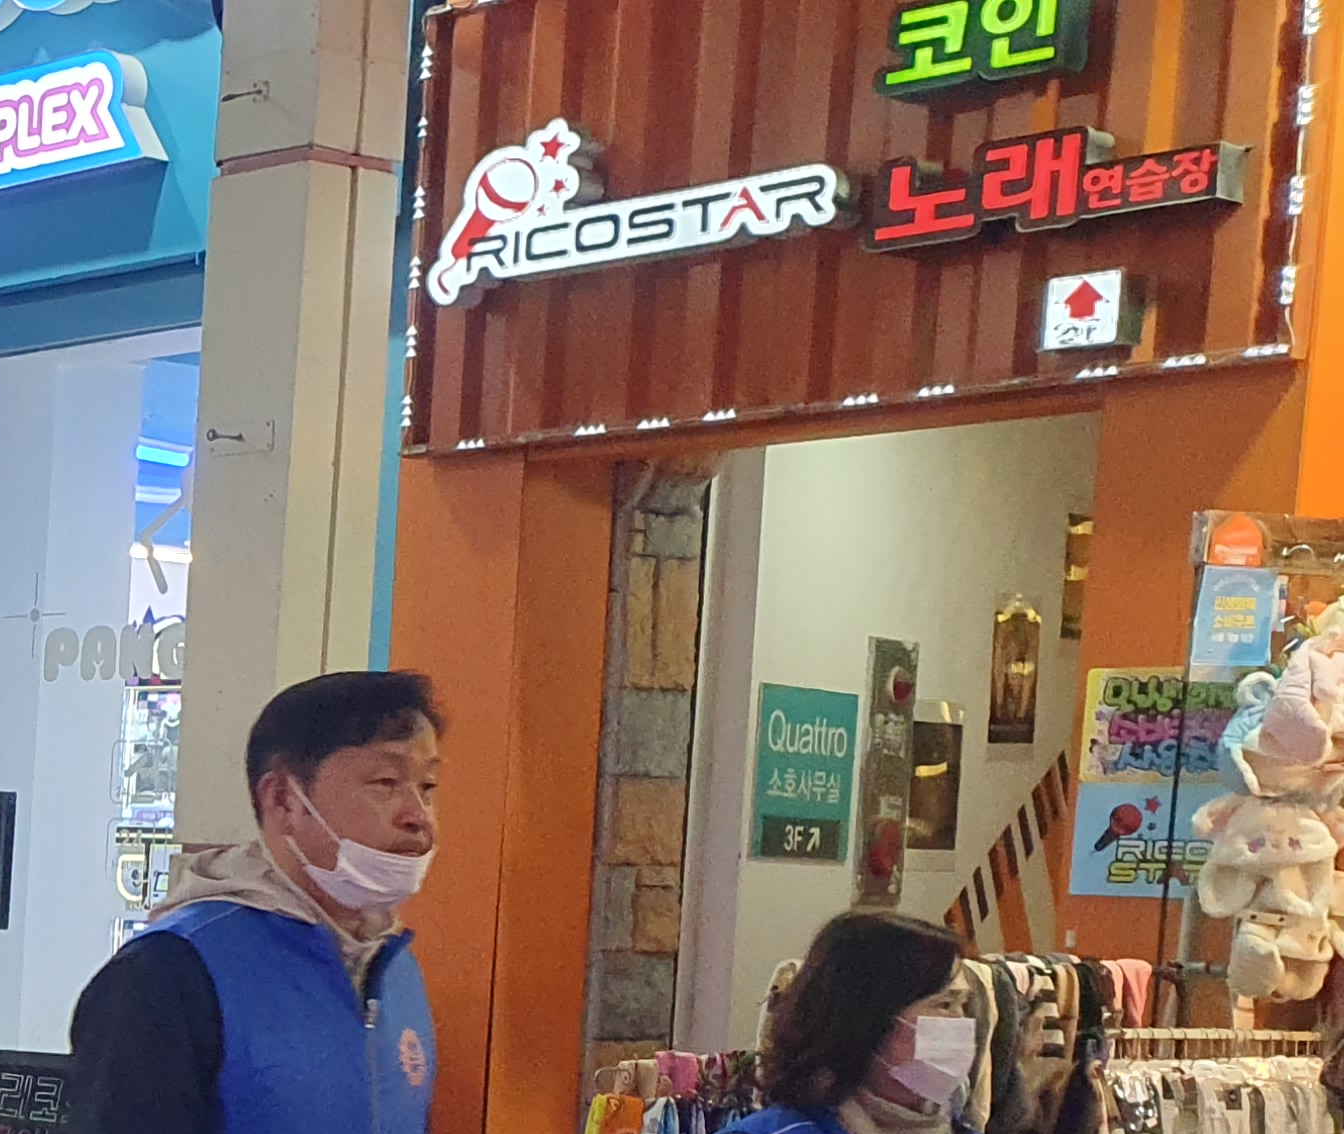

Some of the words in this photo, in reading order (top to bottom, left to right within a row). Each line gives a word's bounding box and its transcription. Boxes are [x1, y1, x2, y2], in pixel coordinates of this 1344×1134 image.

[886, 0, 1059, 85] 코인
[466, 175, 828, 274] RICOSTAR
[43, 624, 185, 683] PANG
[768, 708, 848, 759] Quattro
[766, 767, 841, 804] 소호사무실
[783, 824, 805, 852] 3F
